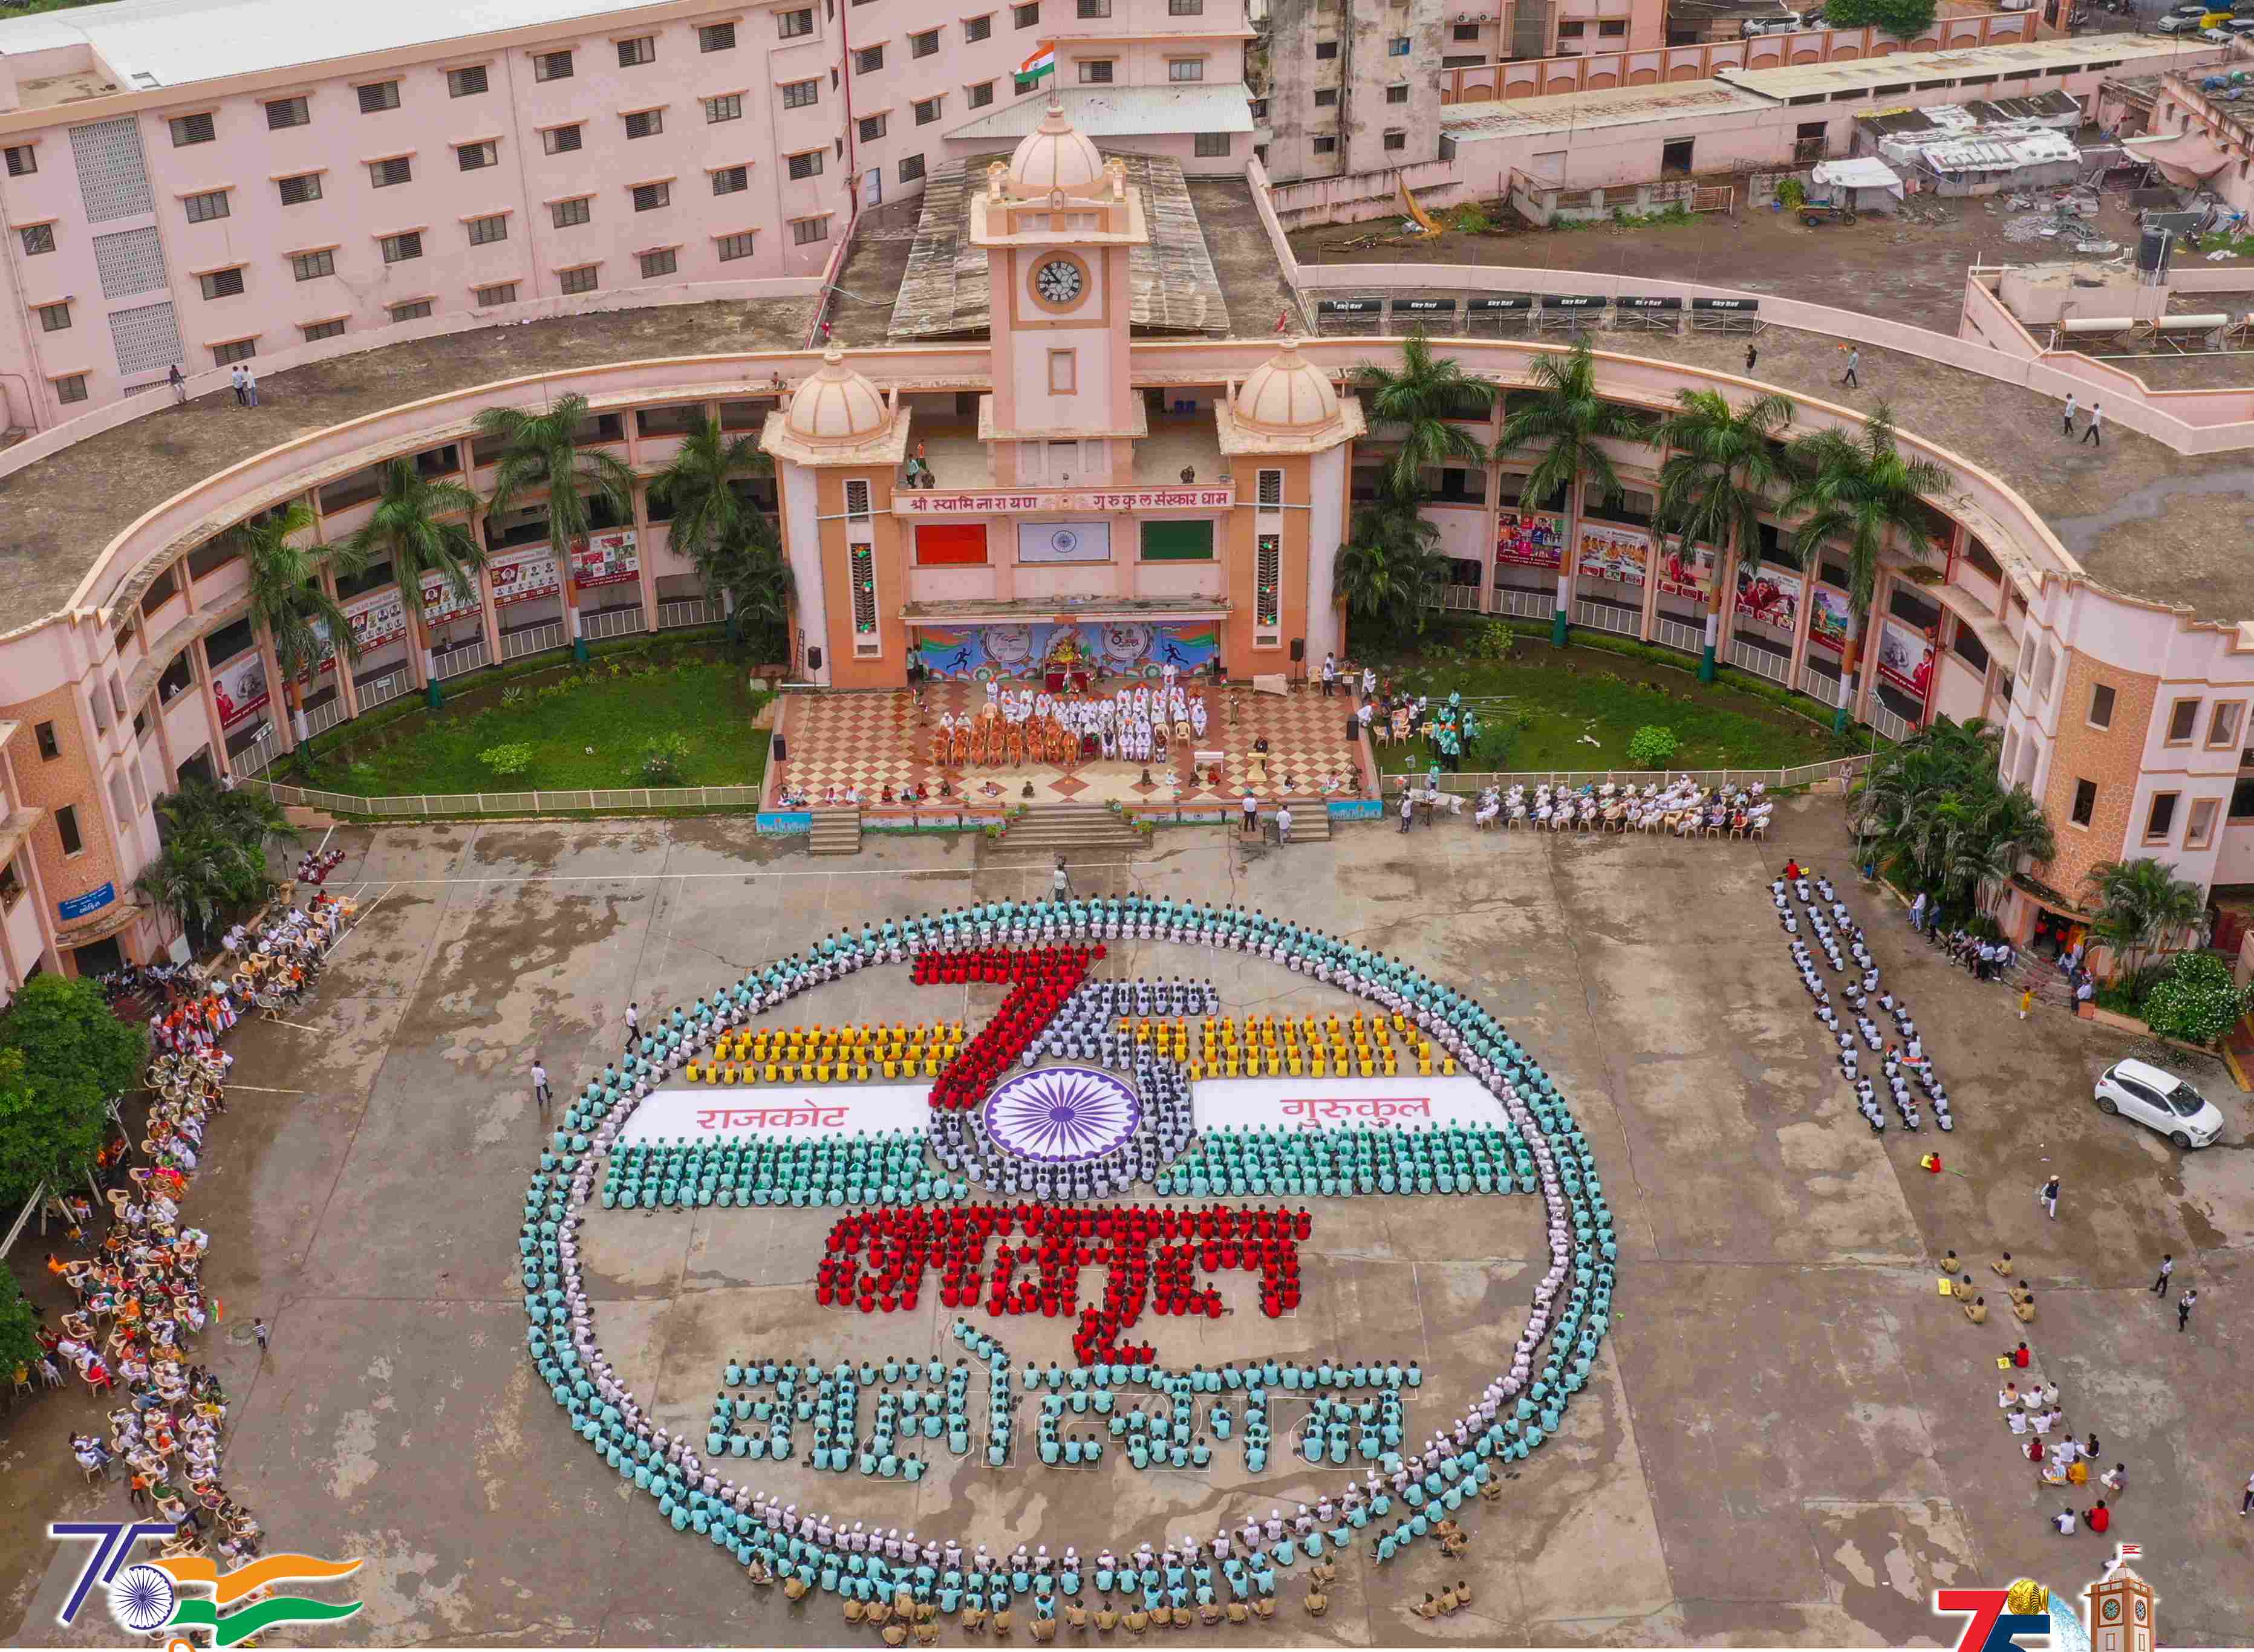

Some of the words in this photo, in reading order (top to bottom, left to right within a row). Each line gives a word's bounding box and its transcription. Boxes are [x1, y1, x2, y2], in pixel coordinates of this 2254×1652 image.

[933, 496, 1037, 511] स्वामिनारायण
[1202, 492, 1228, 505] धाम
[697, 1099, 849, 1129] राजकोट
[1280, 1098, 1430, 1127] गुरुकुल
